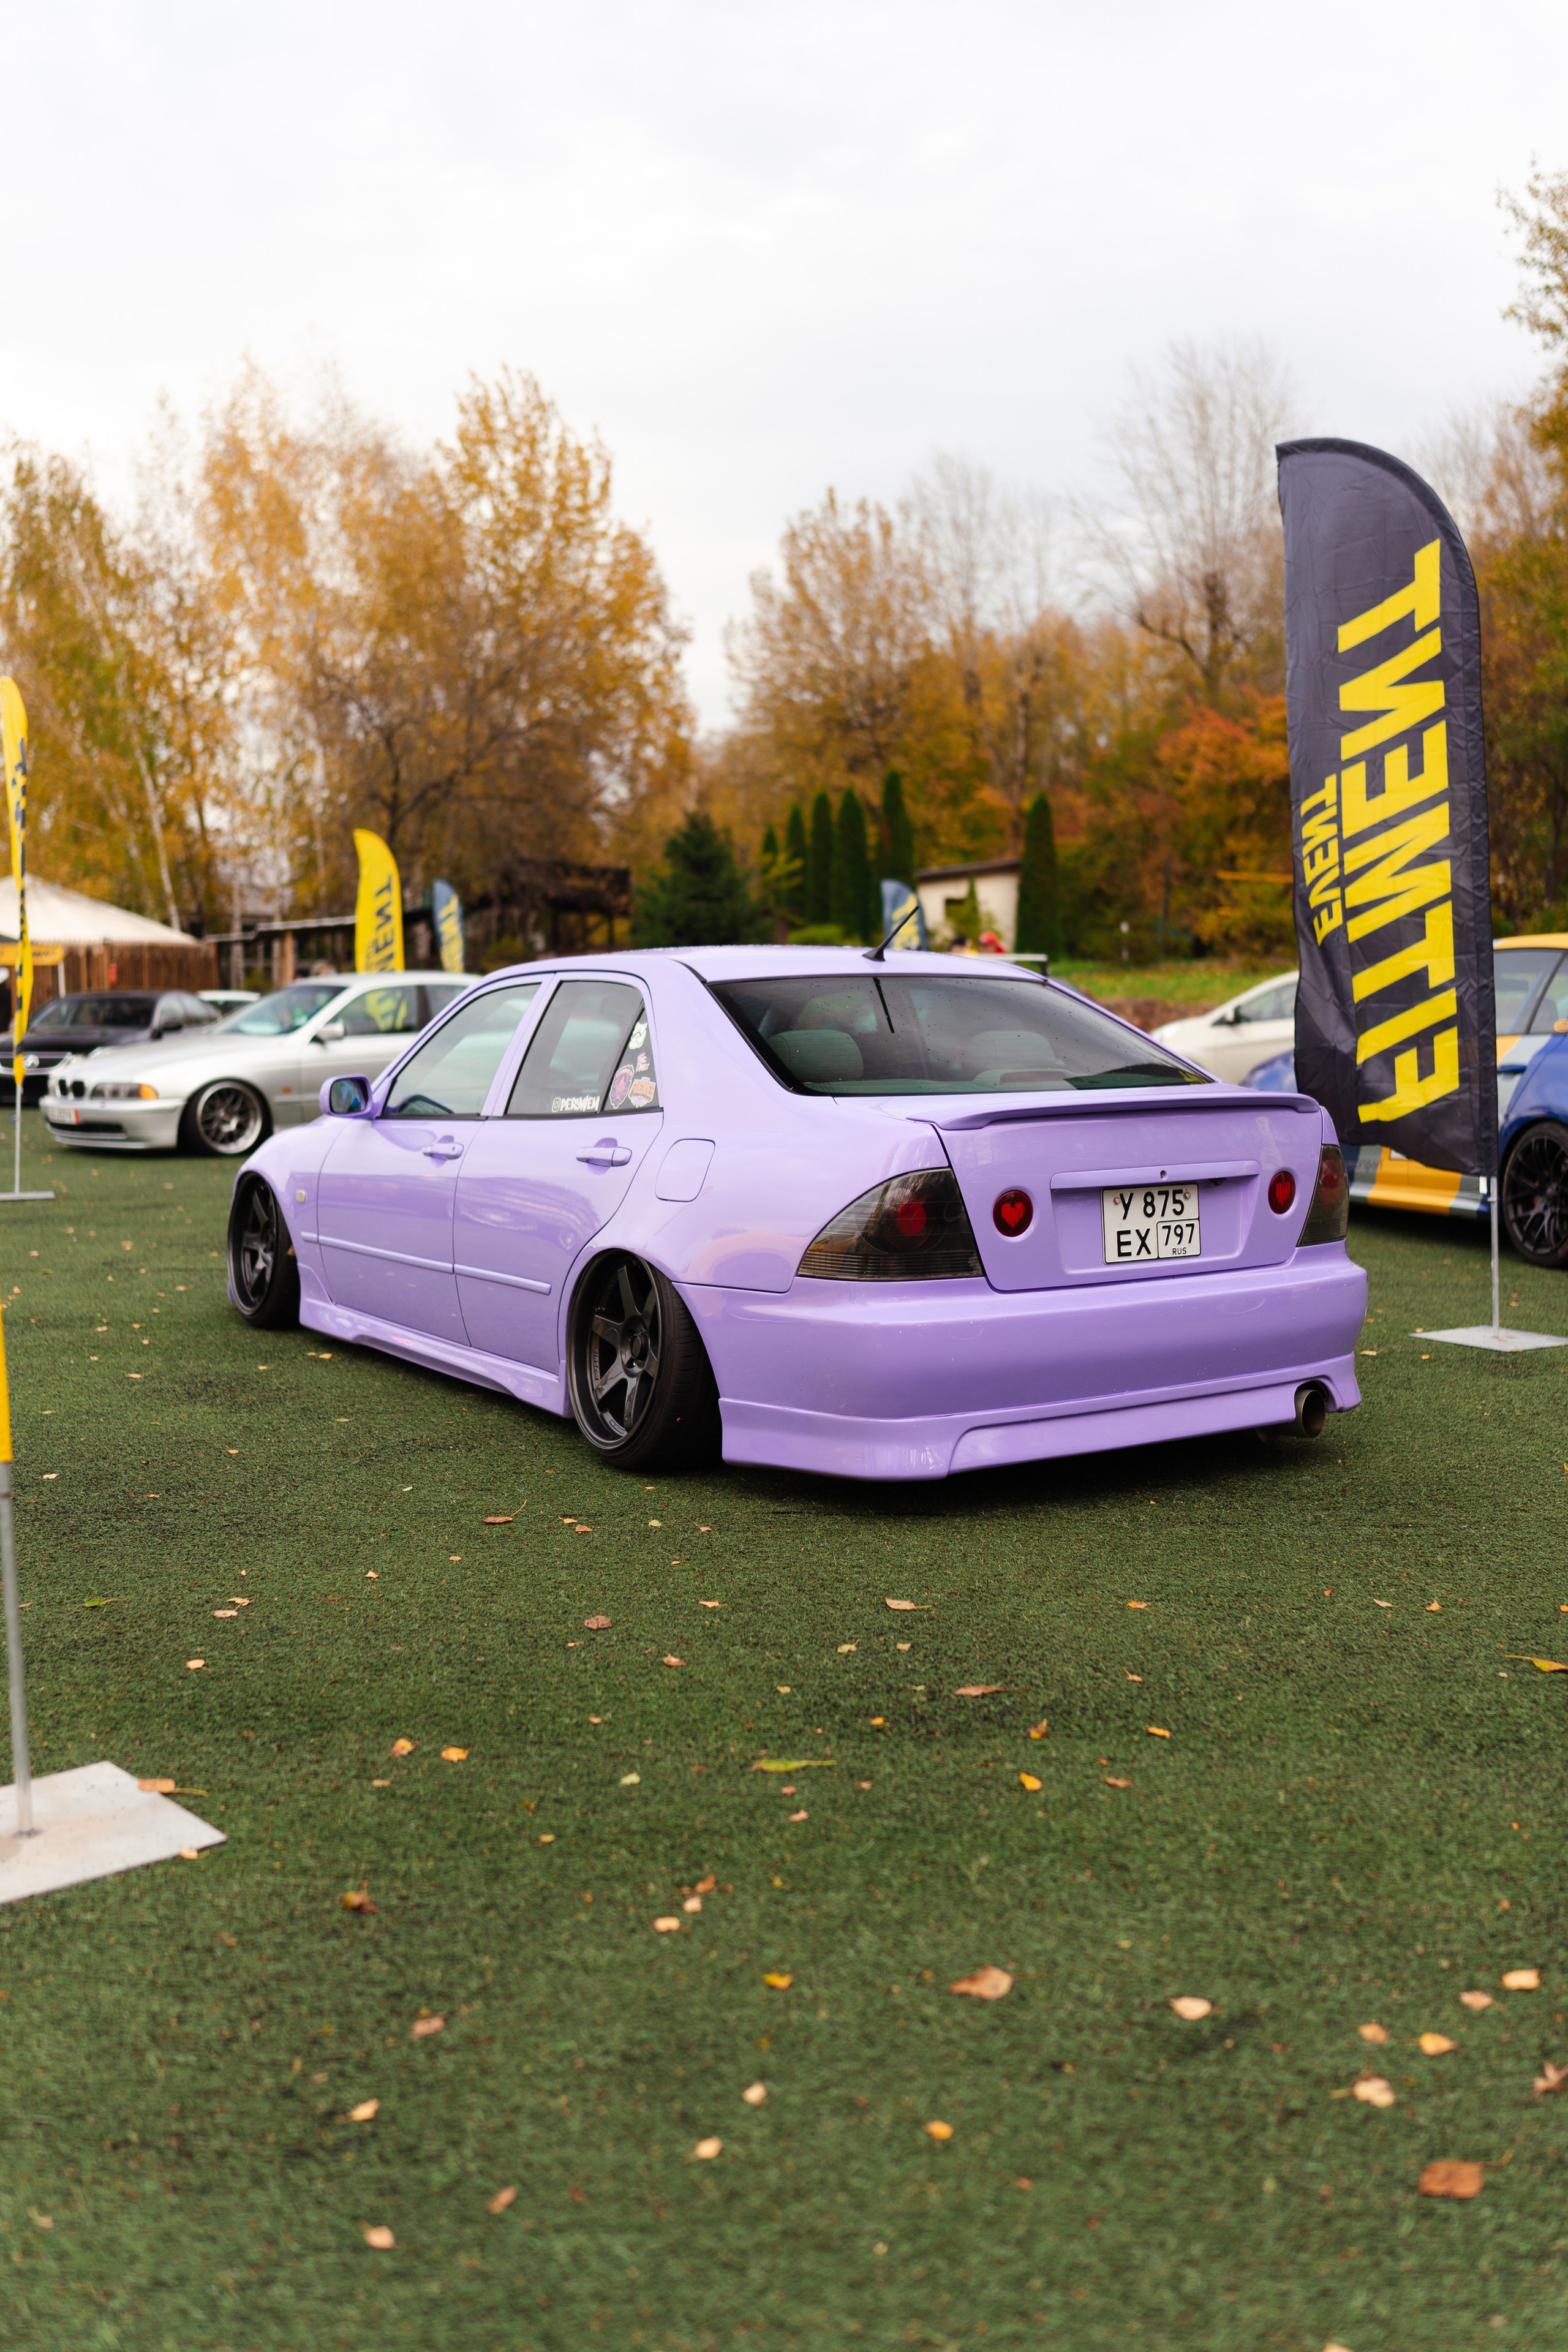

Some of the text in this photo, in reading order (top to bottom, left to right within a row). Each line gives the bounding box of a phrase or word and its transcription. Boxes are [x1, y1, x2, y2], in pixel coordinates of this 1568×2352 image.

[1143, 1189, 1185, 1218] 875
[1116, 1228, 1152, 1257] EX
[1161, 1223, 1196, 1246] 797
[1172, 1246, 1187, 1255] RUS
